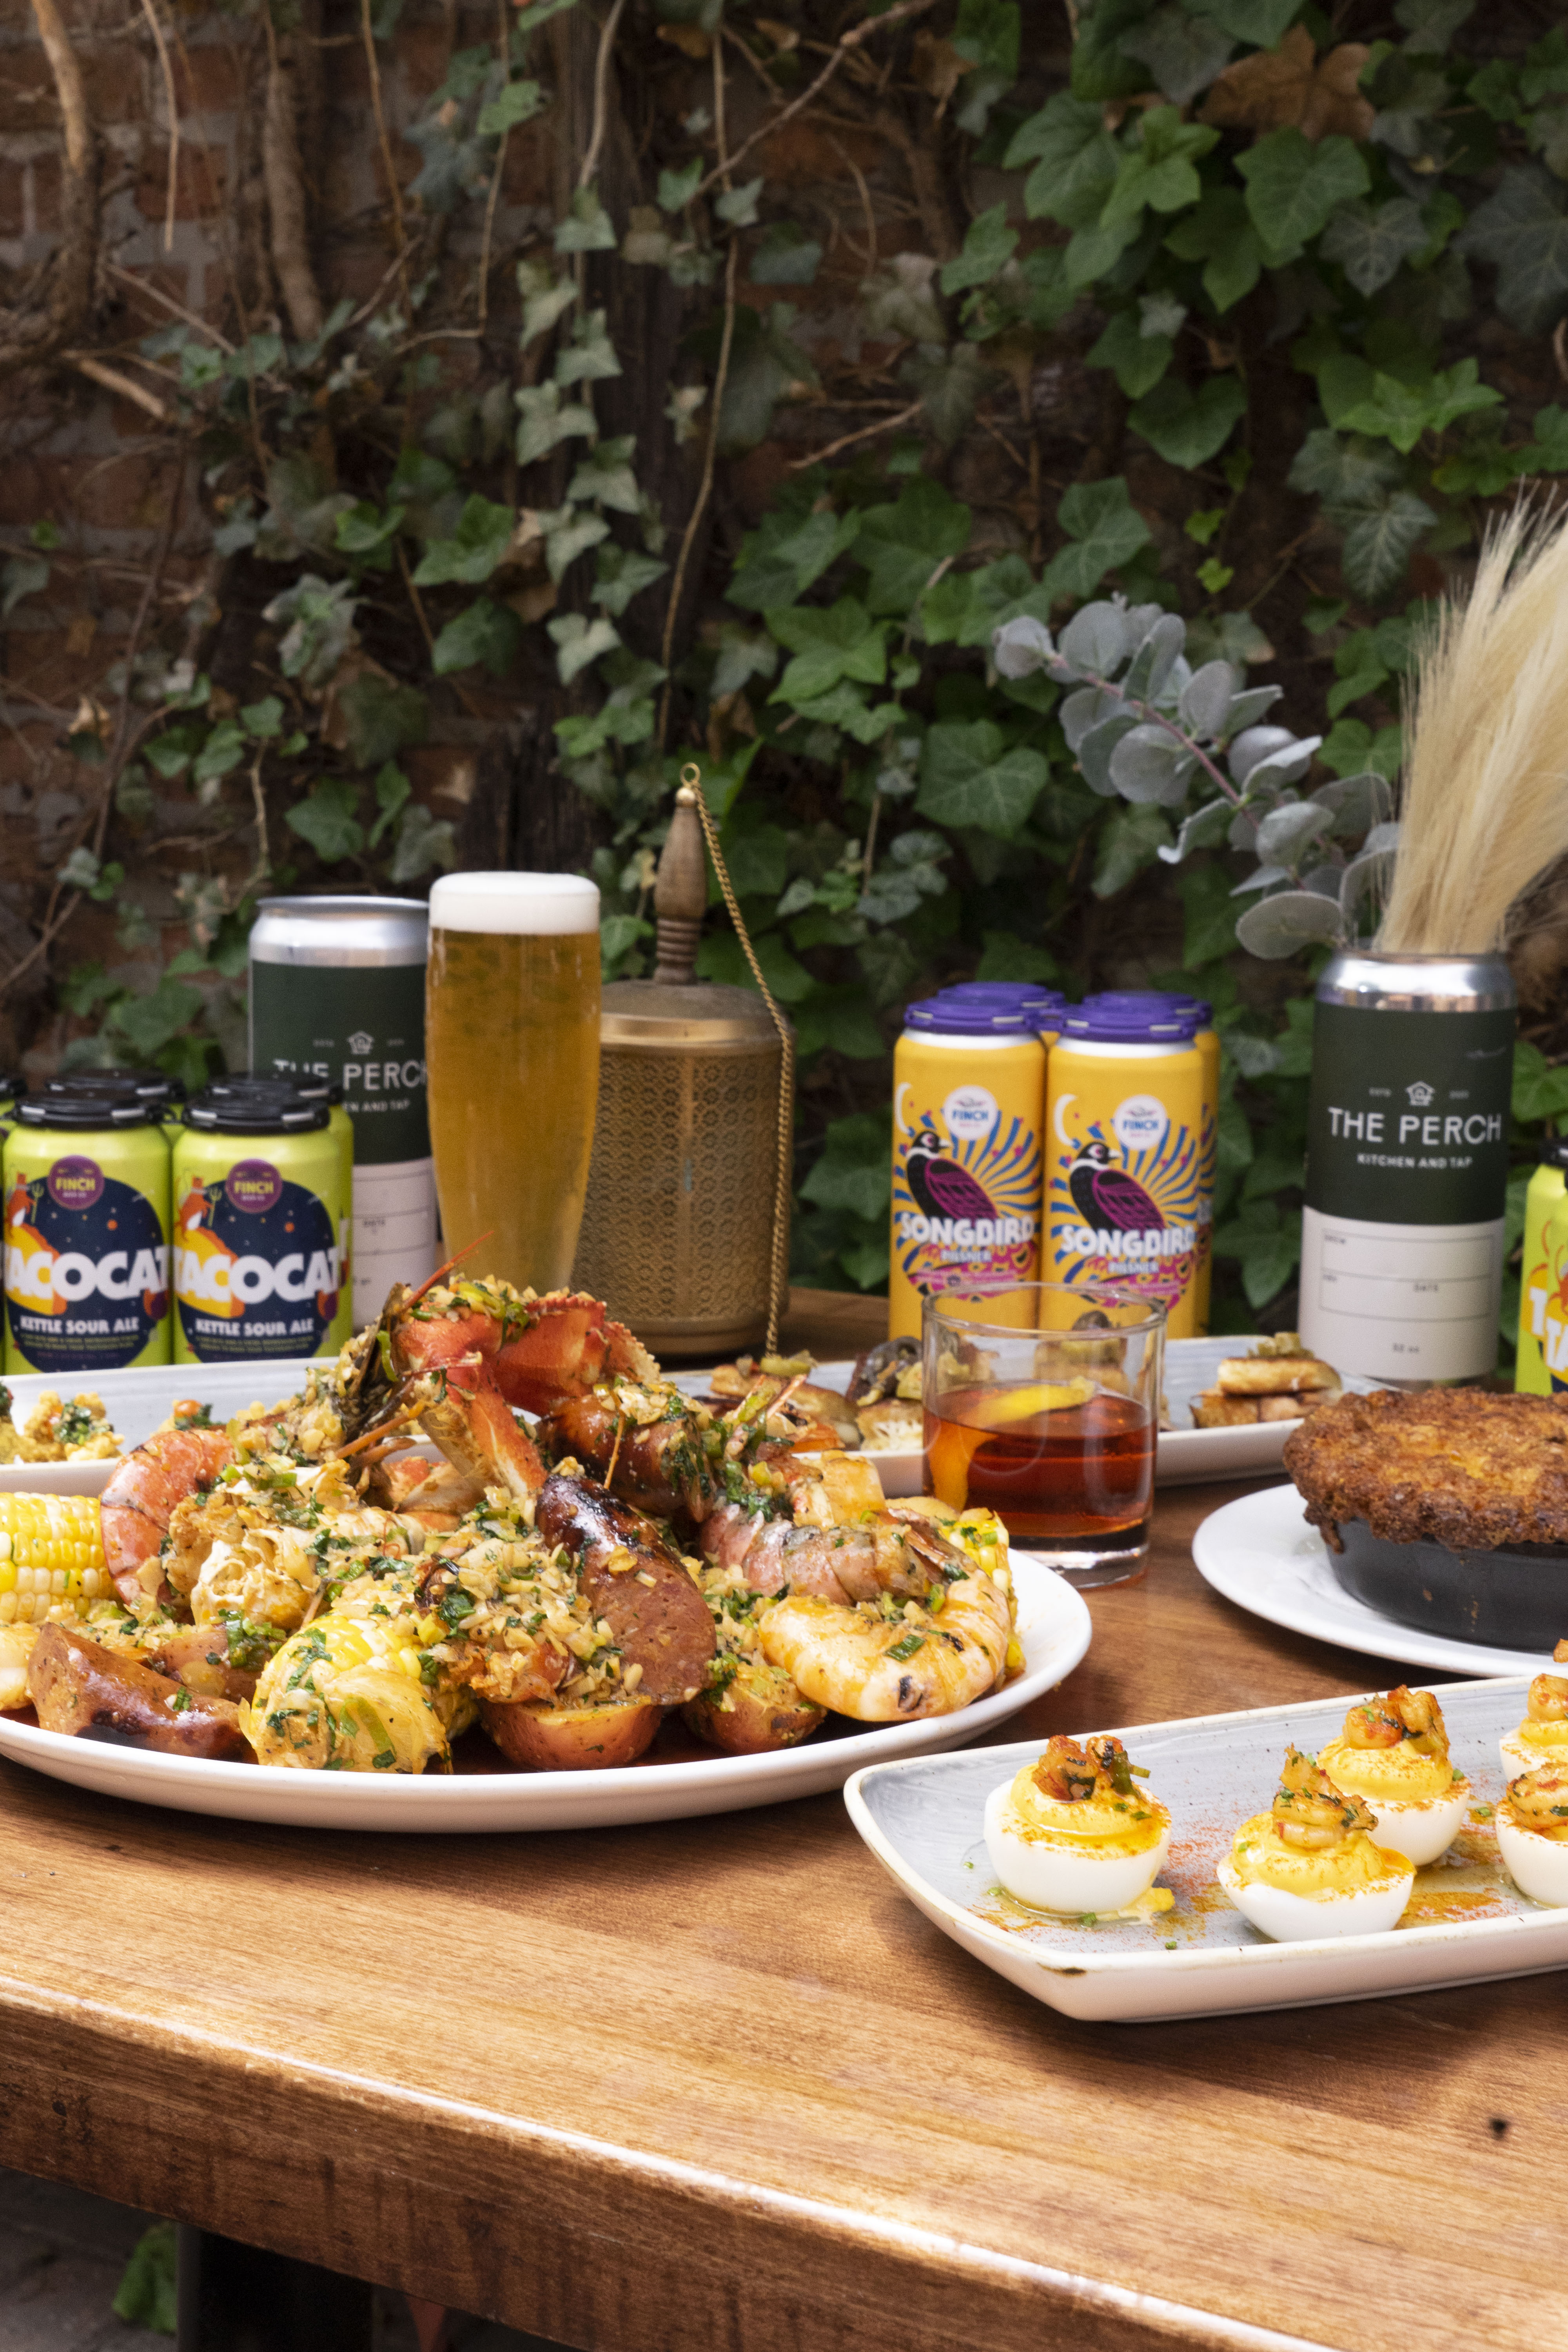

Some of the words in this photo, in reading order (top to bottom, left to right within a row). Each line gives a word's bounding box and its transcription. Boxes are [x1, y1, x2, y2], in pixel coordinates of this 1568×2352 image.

[952, 1110, 989, 1122] FINCH
[1122, 1119, 1159, 1131] FINCH
[1328, 1106, 1384, 1143] THE
[1399, 1113, 1502, 1145] PERCH
[1356, 1153, 1415, 1169] KITCHEN
[1418, 1157, 1447, 1170] AND
[1450, 1156, 1473, 1169] TAP
[55, 1177, 96, 1191] FINCH
[234, 1180, 274, 1194] FINCH
[20, 1315, 63, 1334] KETTLE
[65, 1319, 110, 1335] SOUR
[113, 1316, 139, 1333] ALE
[196, 1318, 240, 1337] KETTLE
[244, 1321, 287, 1337] SOUR
[290, 1317, 314, 1334] ALE
